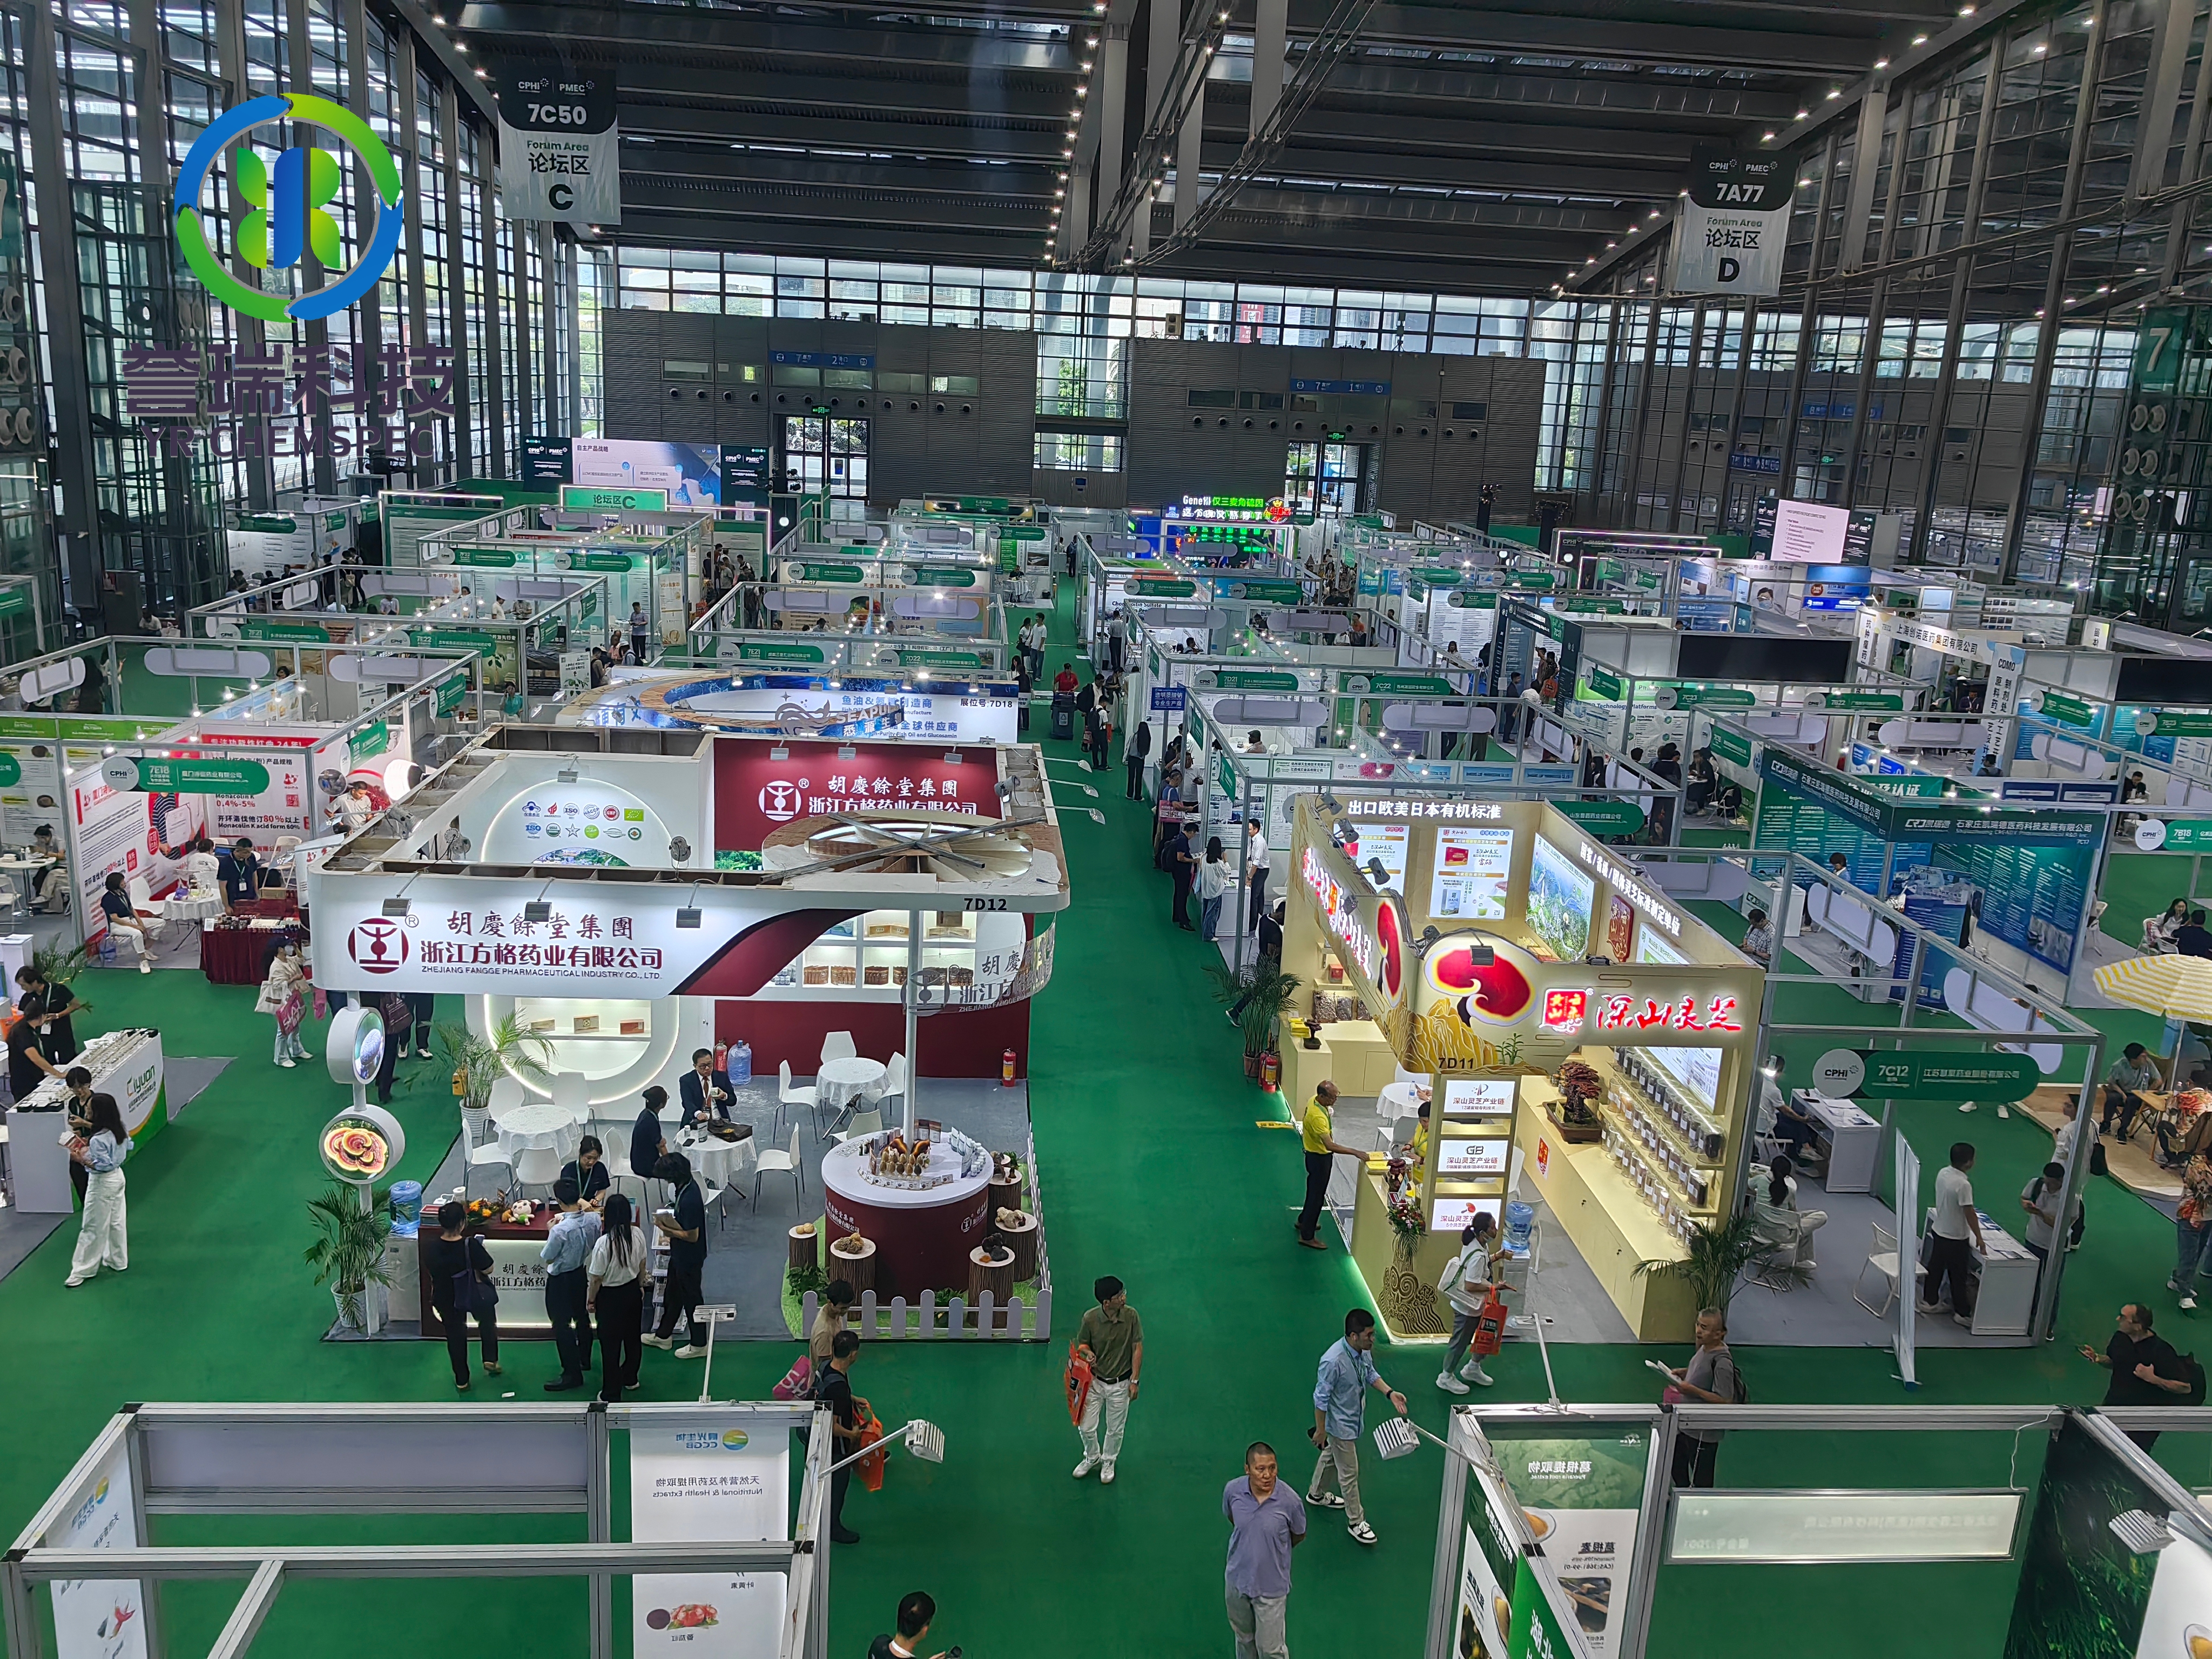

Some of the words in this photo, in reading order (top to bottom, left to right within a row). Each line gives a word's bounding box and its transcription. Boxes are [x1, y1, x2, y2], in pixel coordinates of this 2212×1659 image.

[518, 81, 540, 90] CPHI
[559, 83, 585, 92] PMEC
[528, 104, 587, 125] 7C50
[527, 140, 562, 150] Forum
[563, 142, 589, 151] Area
[528, 152, 591, 175] 论坛区
[1709, 162, 1728, 170] CPHI
[1745, 164, 1769, 172] PMEC
[549, 184, 574, 210] C
[1716, 183, 1765, 203] 7A77
[1707, 217, 1738, 226] Forum
[1739, 218, 1762, 227] Area
[1705, 228, 1761, 249] 论坛区
[1717, 257, 1740, 282] D
[2147, 327, 2171, 373] 7
[593, 494, 622, 504] 论坛区
[622, 495, 636, 509] C
[1897, 623, 1978, 655] 上海创诺医药集团有限公司
[1998, 658, 2015, 672] CDMO
[149, 765, 170, 774] 7E18
[827, 774, 958, 798] 胡慶餘堂集團
[1347, 800, 1502, 820] 出口欧美日本有机标准
[1955, 819, 2093, 833] 石家庄凯瑞德医药科技发展有限公司
[963, 897, 1008, 912] 7D12
[446, 909, 633, 941] 胡慶餘堂集團
[421, 940, 663, 970] 浙江方格药业有限公司
[421, 966, 463, 974] ZHEJIANG
[466, 967, 501, 975] FANGGE
[502, 968, 580, 977] PHARMACEUTICAL
[582, 970, 624, 979] INDUSTRY
[1438, 1057, 1475, 1069] 7D11
[1824, 1069, 1848, 1078] CPHI
[1878, 1065, 1908, 1076] 7C12
[1453, 1097, 1505, 1106] 深山灵芝产业链
[1446, 1156, 1498, 1165] 深山灵芝产业链
